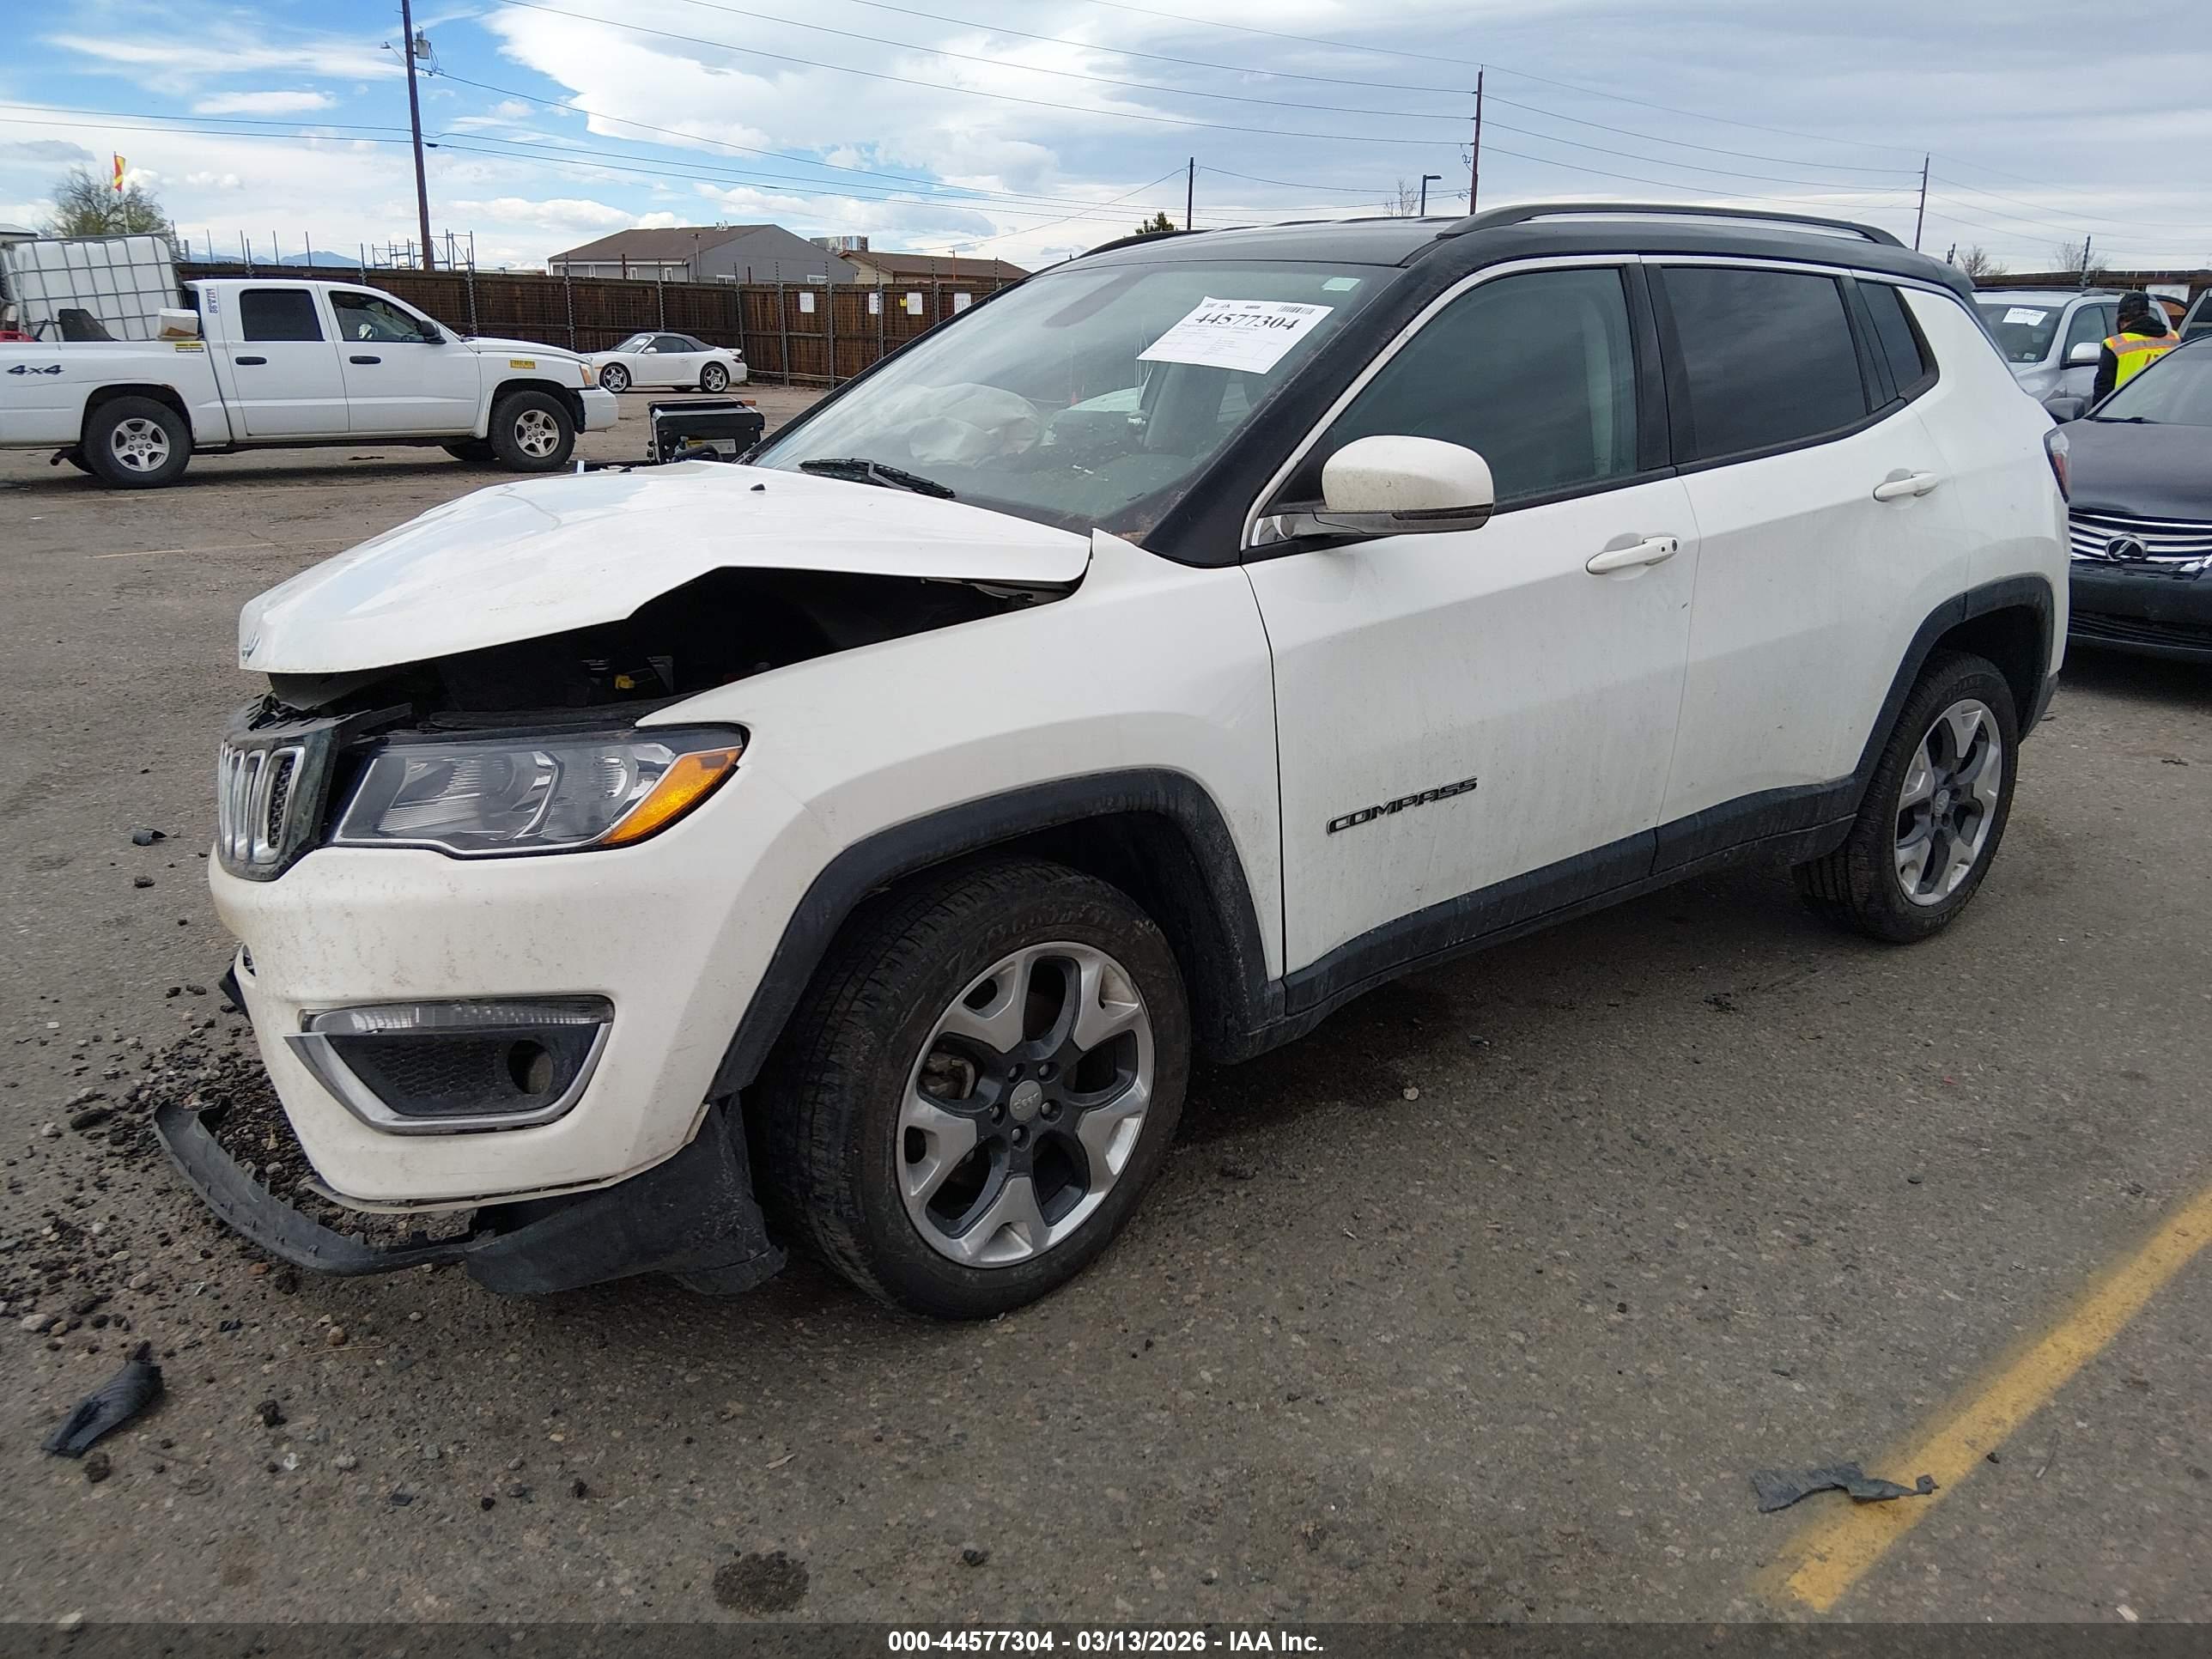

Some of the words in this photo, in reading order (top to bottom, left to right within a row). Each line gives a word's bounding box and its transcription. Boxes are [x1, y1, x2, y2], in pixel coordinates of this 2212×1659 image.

[1195, 312, 1300, 331] 44577304
[7, 365, 65, 375] 4x4
[1327, 776, 1477, 835] COMPASS
